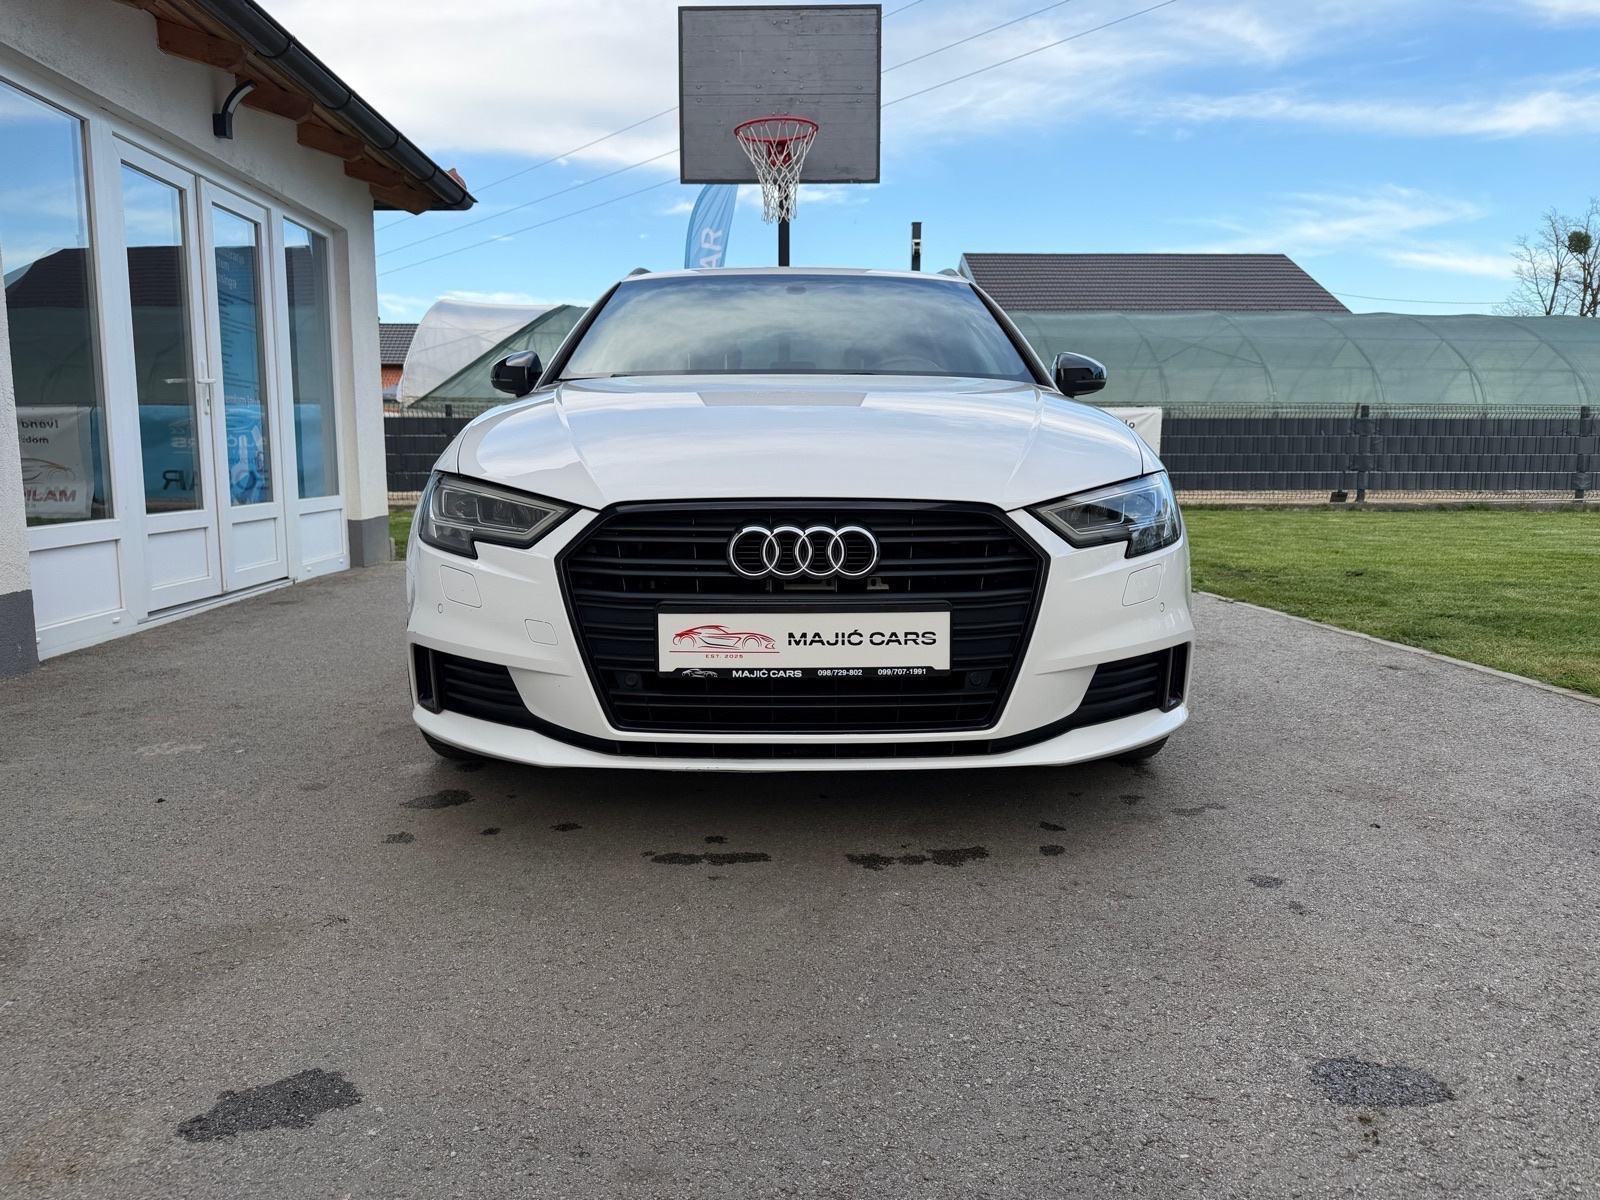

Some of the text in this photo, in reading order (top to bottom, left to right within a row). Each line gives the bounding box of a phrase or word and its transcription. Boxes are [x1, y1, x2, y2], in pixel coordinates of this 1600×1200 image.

[787, 629, 937, 646] MAJIĆ CARS
[769, 669, 803, 678] CARS
[817, 668, 863, 677] 098/729-802
[877, 668, 927, 676] 099/707-1991
